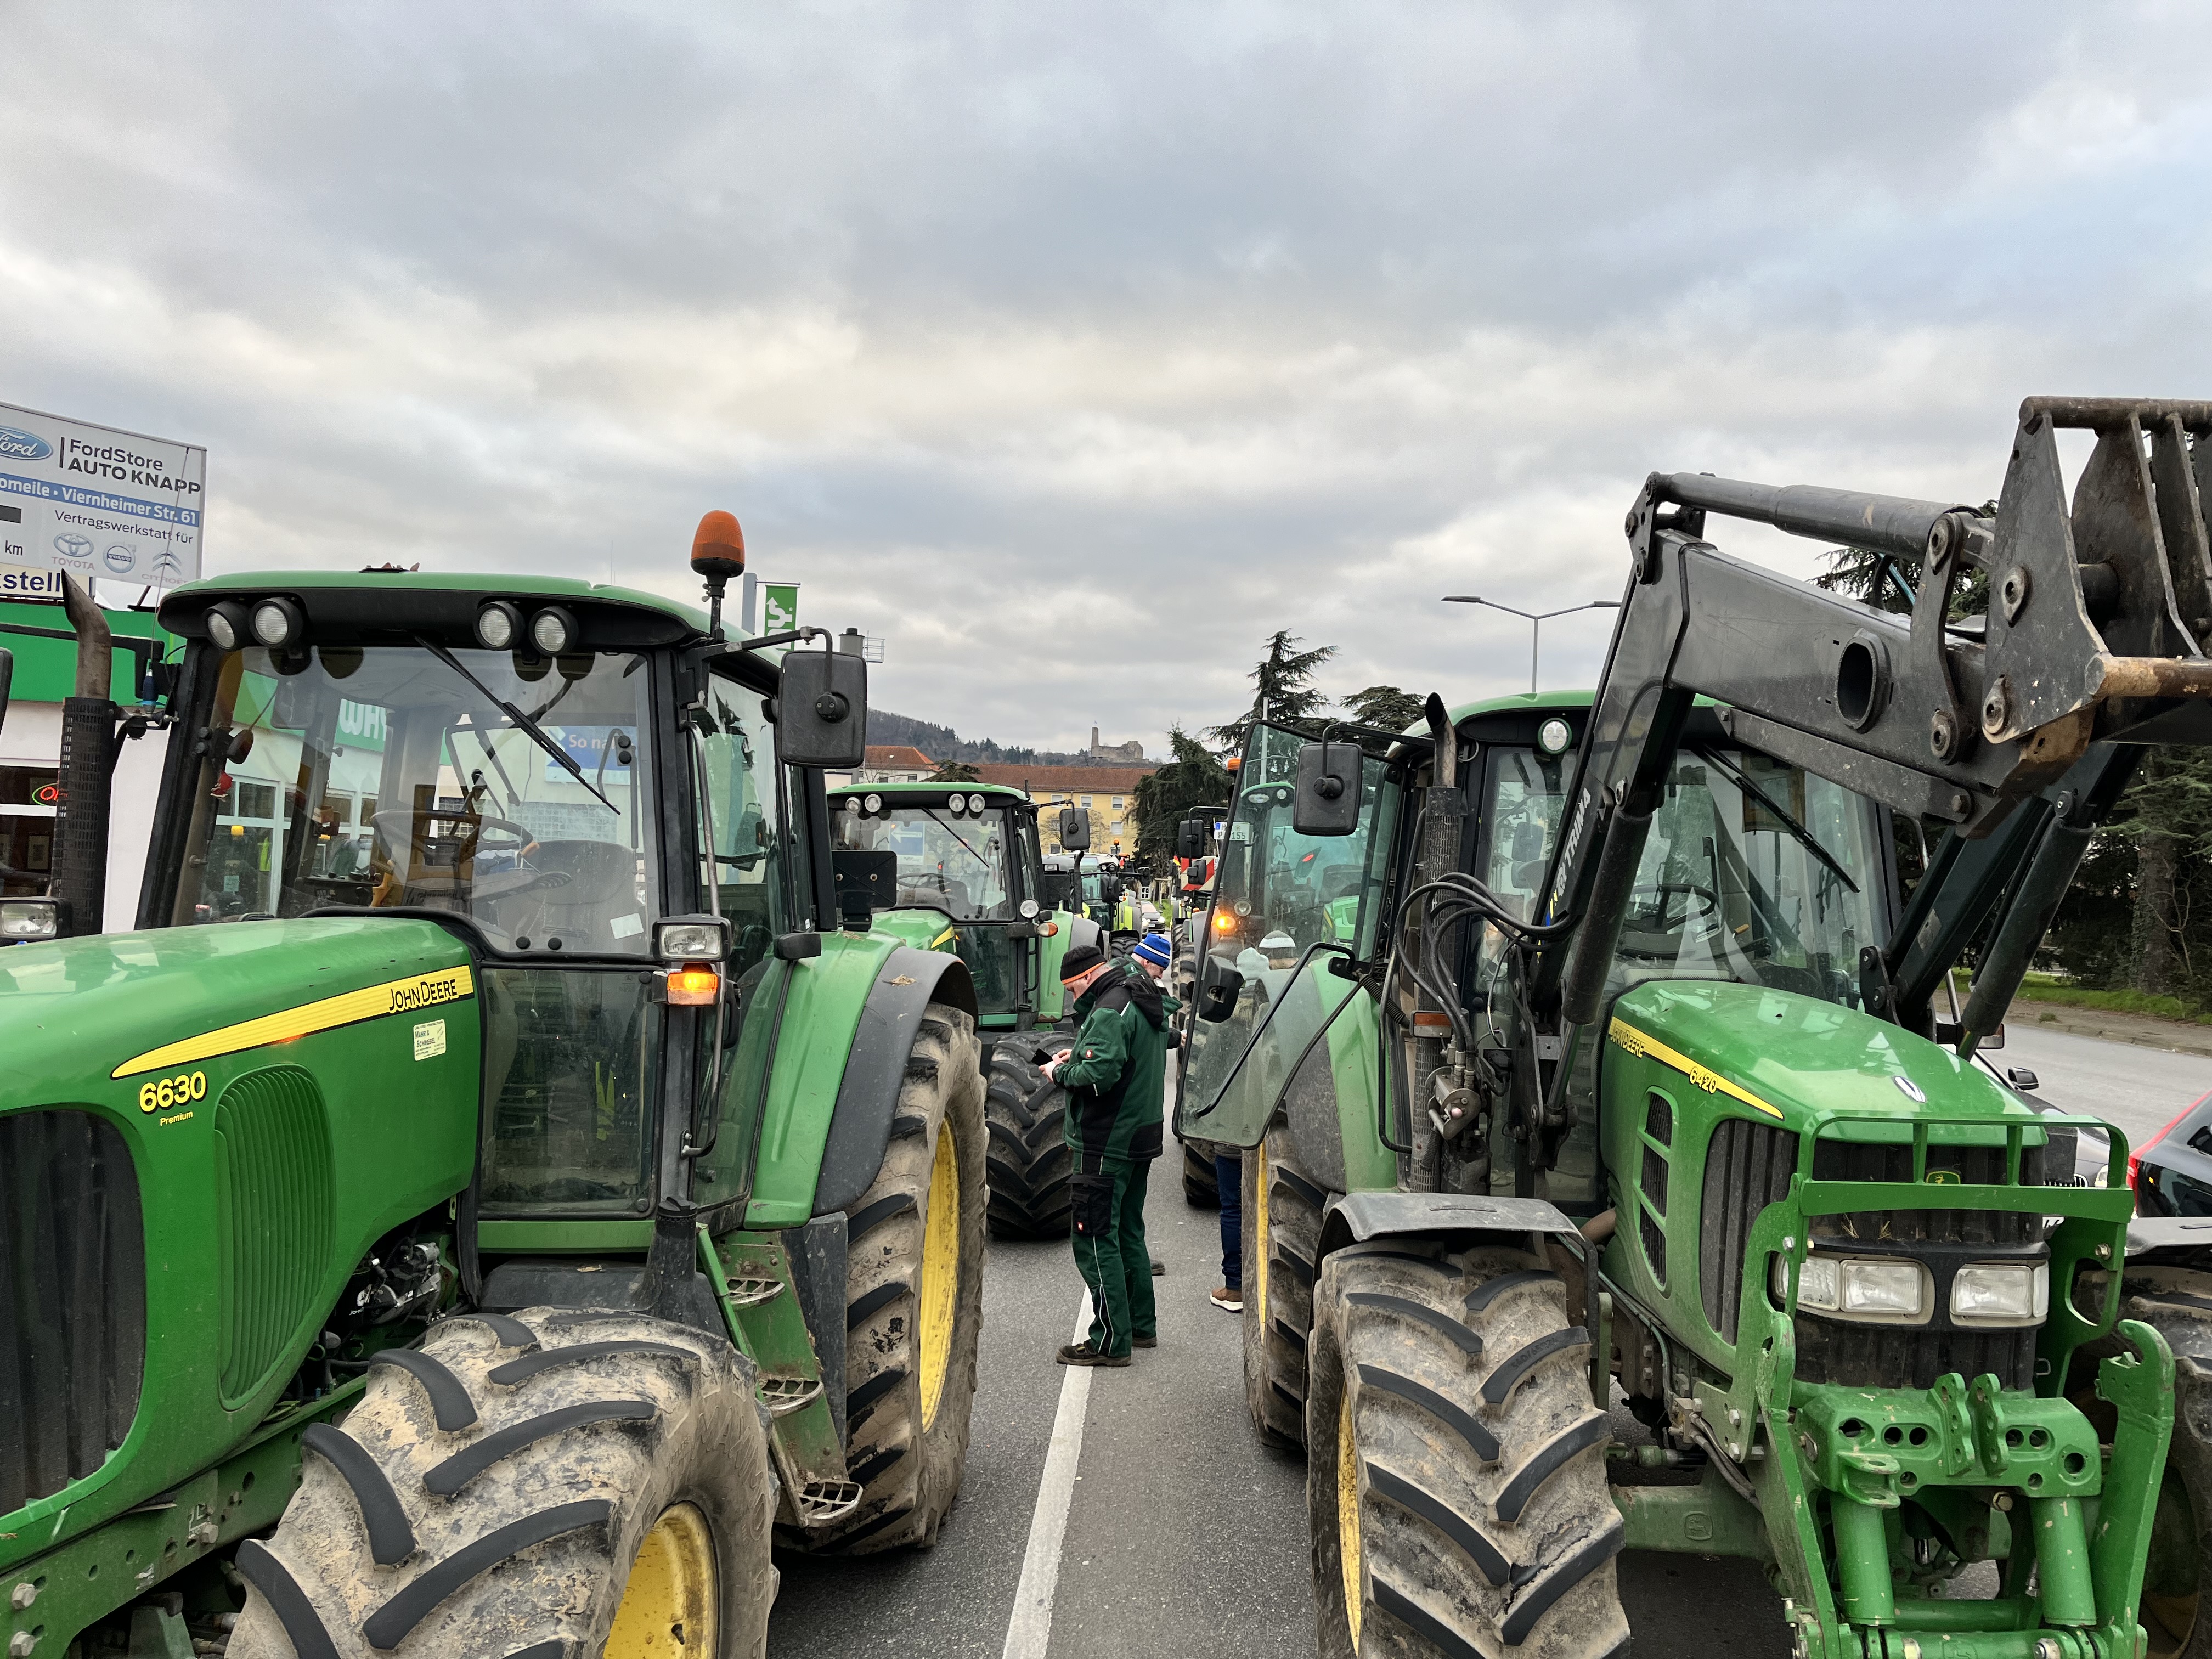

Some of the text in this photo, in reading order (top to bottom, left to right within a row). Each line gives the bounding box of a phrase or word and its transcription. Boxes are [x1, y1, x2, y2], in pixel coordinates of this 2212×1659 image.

[70, 439, 163, 471] FordStore
[68, 458, 201, 494] AUTO KNAPP
[61, 487, 151, 516] Viernheimer
[154, 505, 178, 521] Str.
[181, 512, 196, 524] 61
[55, 510, 193, 544] Vertragswerkstatt für
[5, 540, 23, 556] km
[52, 557, 95, 571] TOYOTA
[0, 571, 61, 592] stell
[569, 734, 588, 748] So
[389, 979, 458, 1011] JOHN DEERE
[139, 1070, 207, 1114] 6630
[1690, 1066, 1718, 1094] 6420
[160, 1111, 194, 1126] Premium
